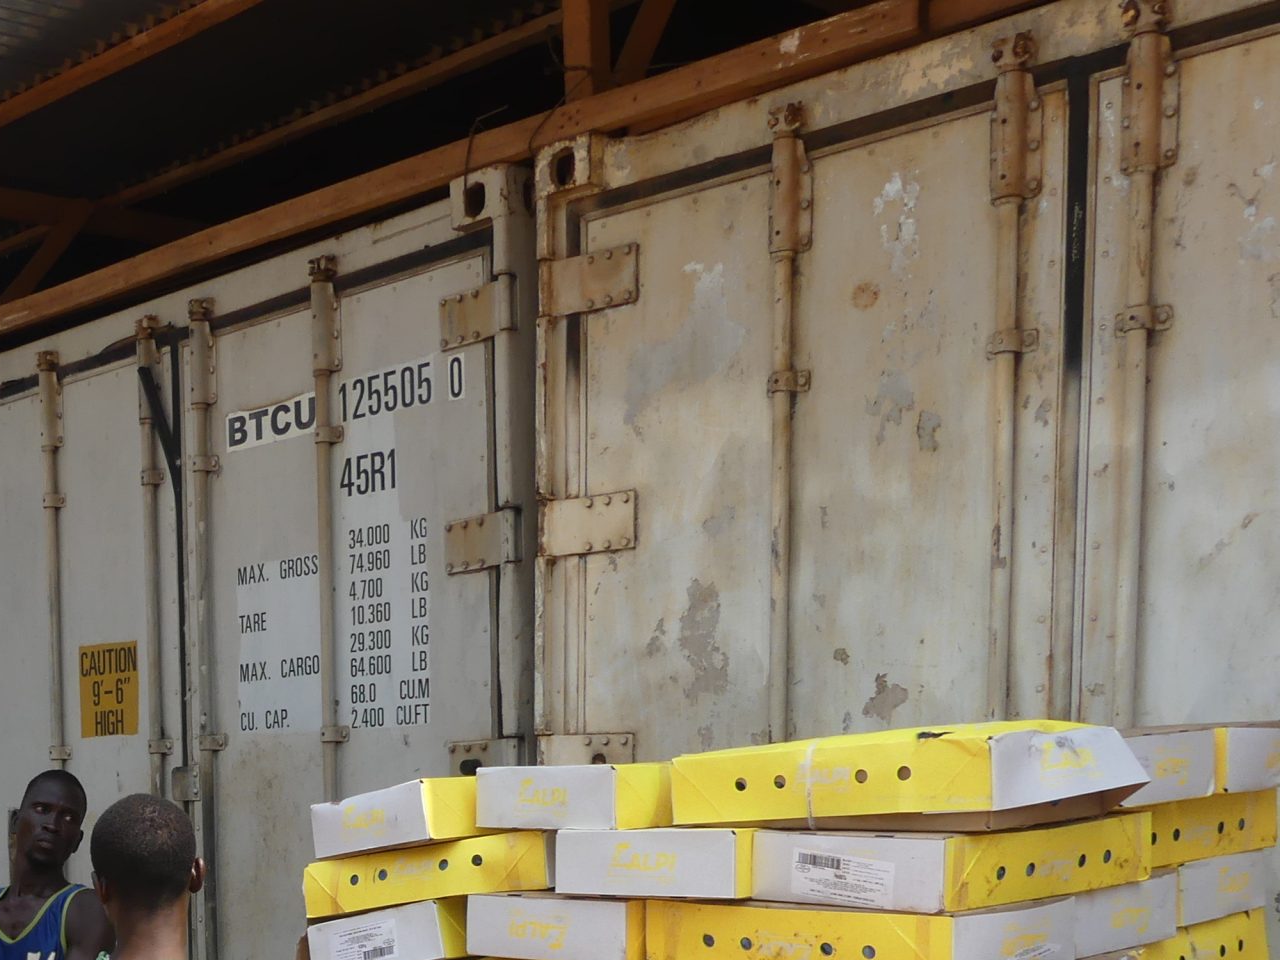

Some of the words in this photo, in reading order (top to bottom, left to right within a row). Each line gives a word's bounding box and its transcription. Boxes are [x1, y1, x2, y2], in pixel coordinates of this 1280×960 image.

[228, 397, 316, 448] BTCU
[339, 361, 432, 422] 125505
[450, 357, 463, 398] 0
[340, 449, 397, 497] 45R1
[348, 523, 390, 550] 34.000
[410, 518, 428, 539] KG
[238, 565, 269, 587] MAX.
[280, 555, 319, 580] GROSS
[349, 550, 391, 575] 74.960
[411, 545, 427, 566] LB
[349, 578, 383, 601] 4.700
[411, 571, 429, 593] KG
[239, 613, 267, 634] TARE
[351, 603, 391, 626] 10.360
[411, 598, 427, 619] LB
[350, 630, 391, 653] 29.300
[411, 625, 429, 646] KG
[81, 646, 137, 677] CAUTION
[240, 662, 271, 683] MAX.
[281, 655, 320, 679] CARGO
[350, 655, 392, 678] 64.600
[411, 651, 428, 672] LB
[351, 683, 377, 704] 68.0
[399, 678, 430, 701] CU.M
[95, 708, 124, 736] HIGH
[241, 711, 259, 731] CU.
[265, 709, 290, 730] CAP.
[351, 706, 385, 729] 2.400
[396, 704, 429, 727] CU.FT
